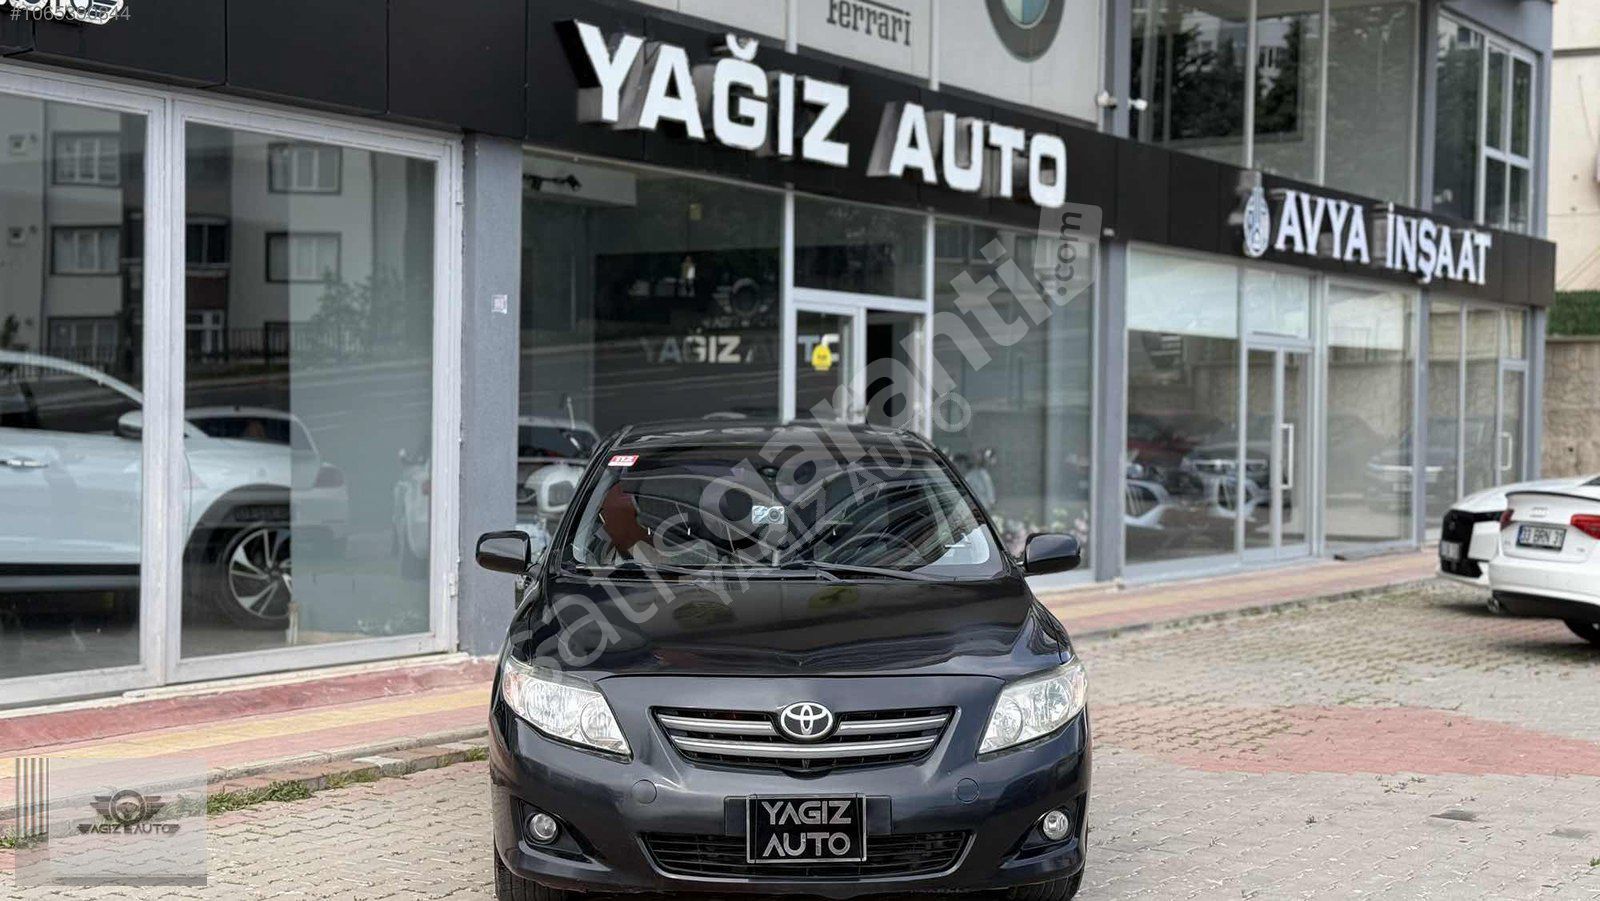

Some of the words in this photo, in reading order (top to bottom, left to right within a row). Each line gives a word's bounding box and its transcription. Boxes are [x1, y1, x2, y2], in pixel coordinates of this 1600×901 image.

[573, 20, 850, 167] YAĞIZ
[888, 102, 1067, 208] AUTO
[1274, 190, 1370, 263] AVYA
[1385, 202, 1492, 284] İNŞAAT
[761, 800, 852, 825] YAGIZ
[762, 832, 851, 857] AUTO
